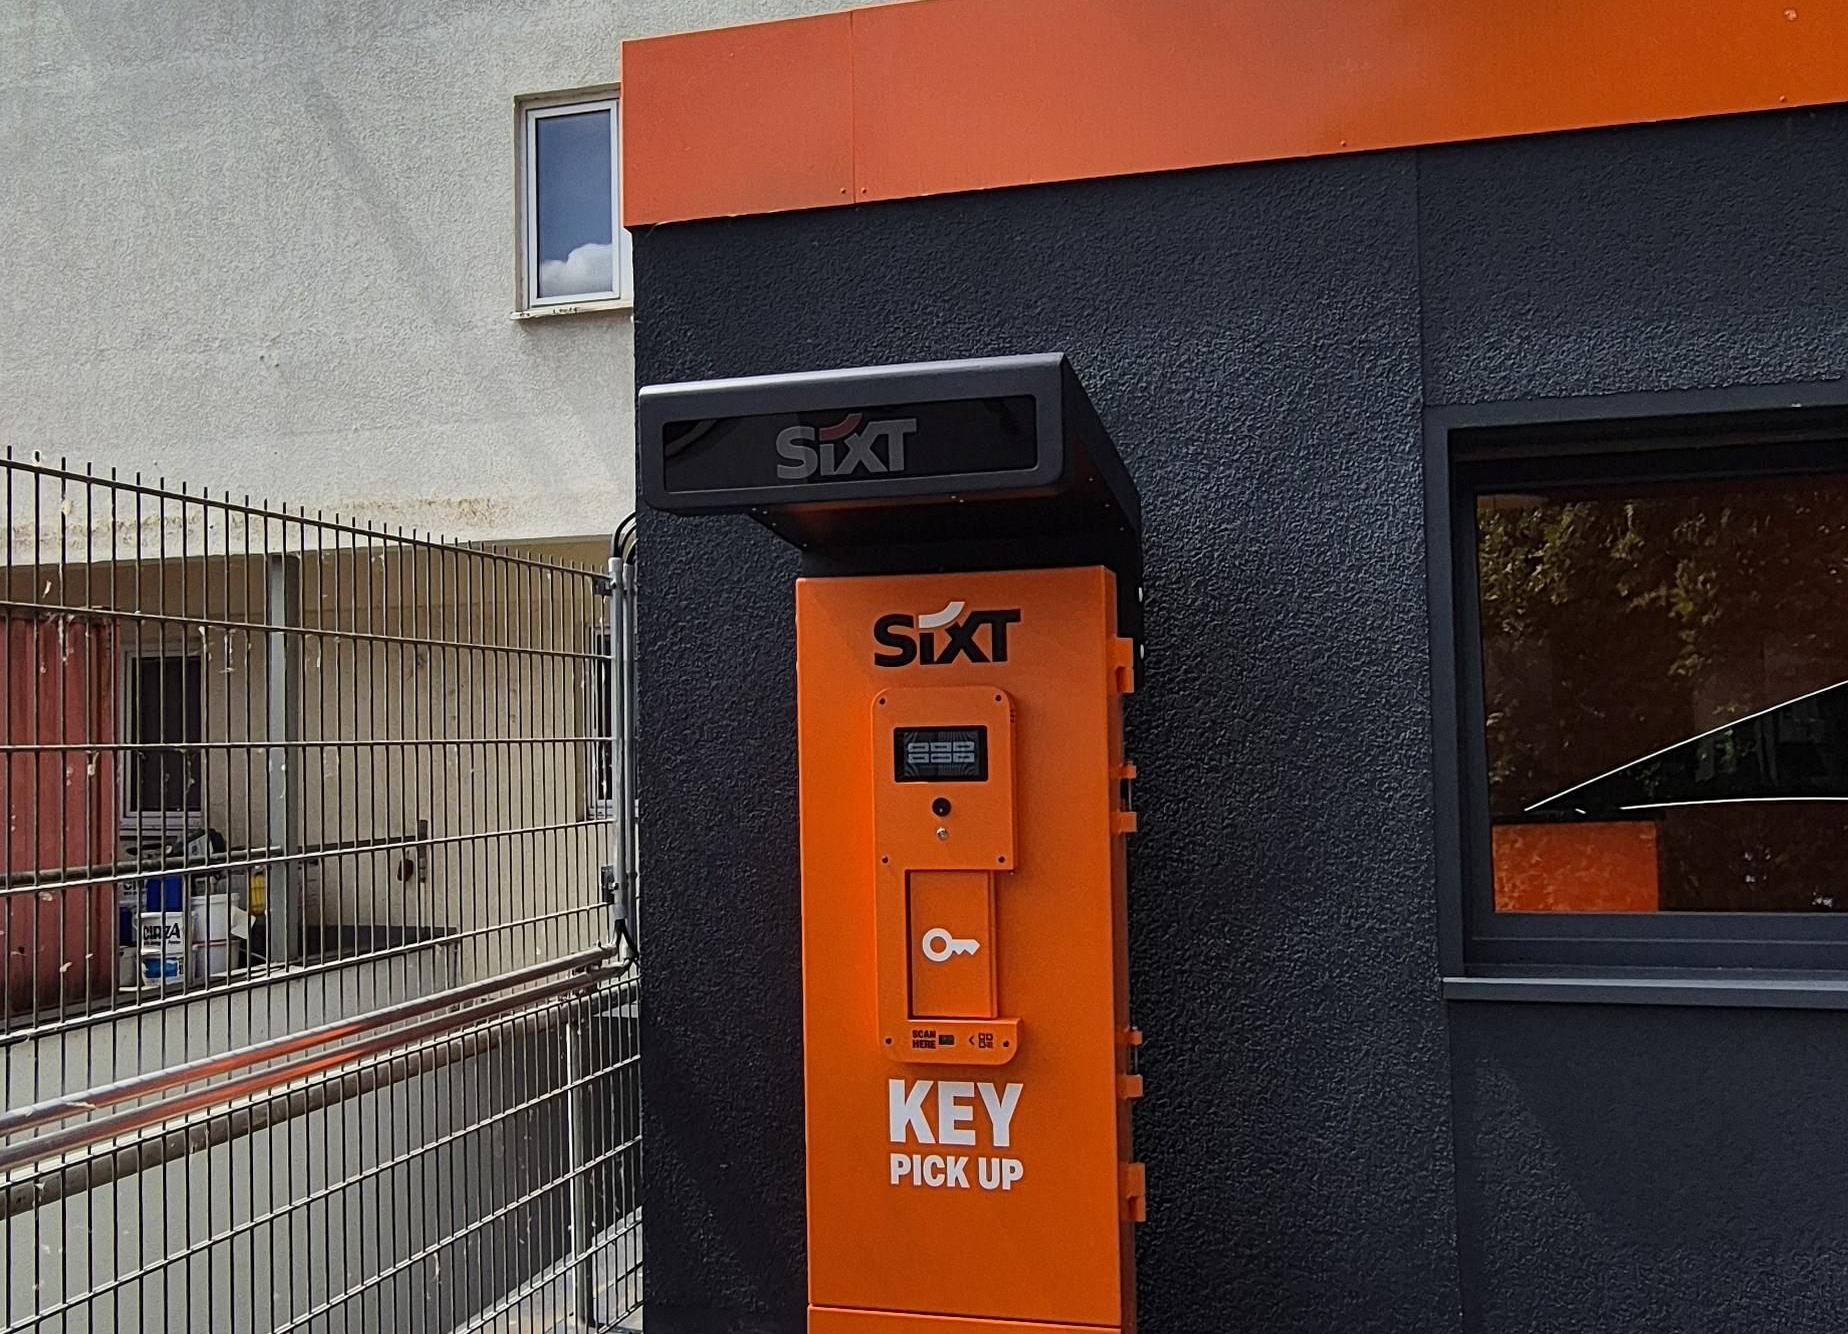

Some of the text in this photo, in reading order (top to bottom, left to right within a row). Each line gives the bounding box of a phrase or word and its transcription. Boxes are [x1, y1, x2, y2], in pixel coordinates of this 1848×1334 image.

[912, 1030, 936, 1038] SCAN
[912, 1040, 936, 1049] HERE
[889, 1079, 1024, 1147] KEY
[890, 1153, 1024, 1190] PICK UP
